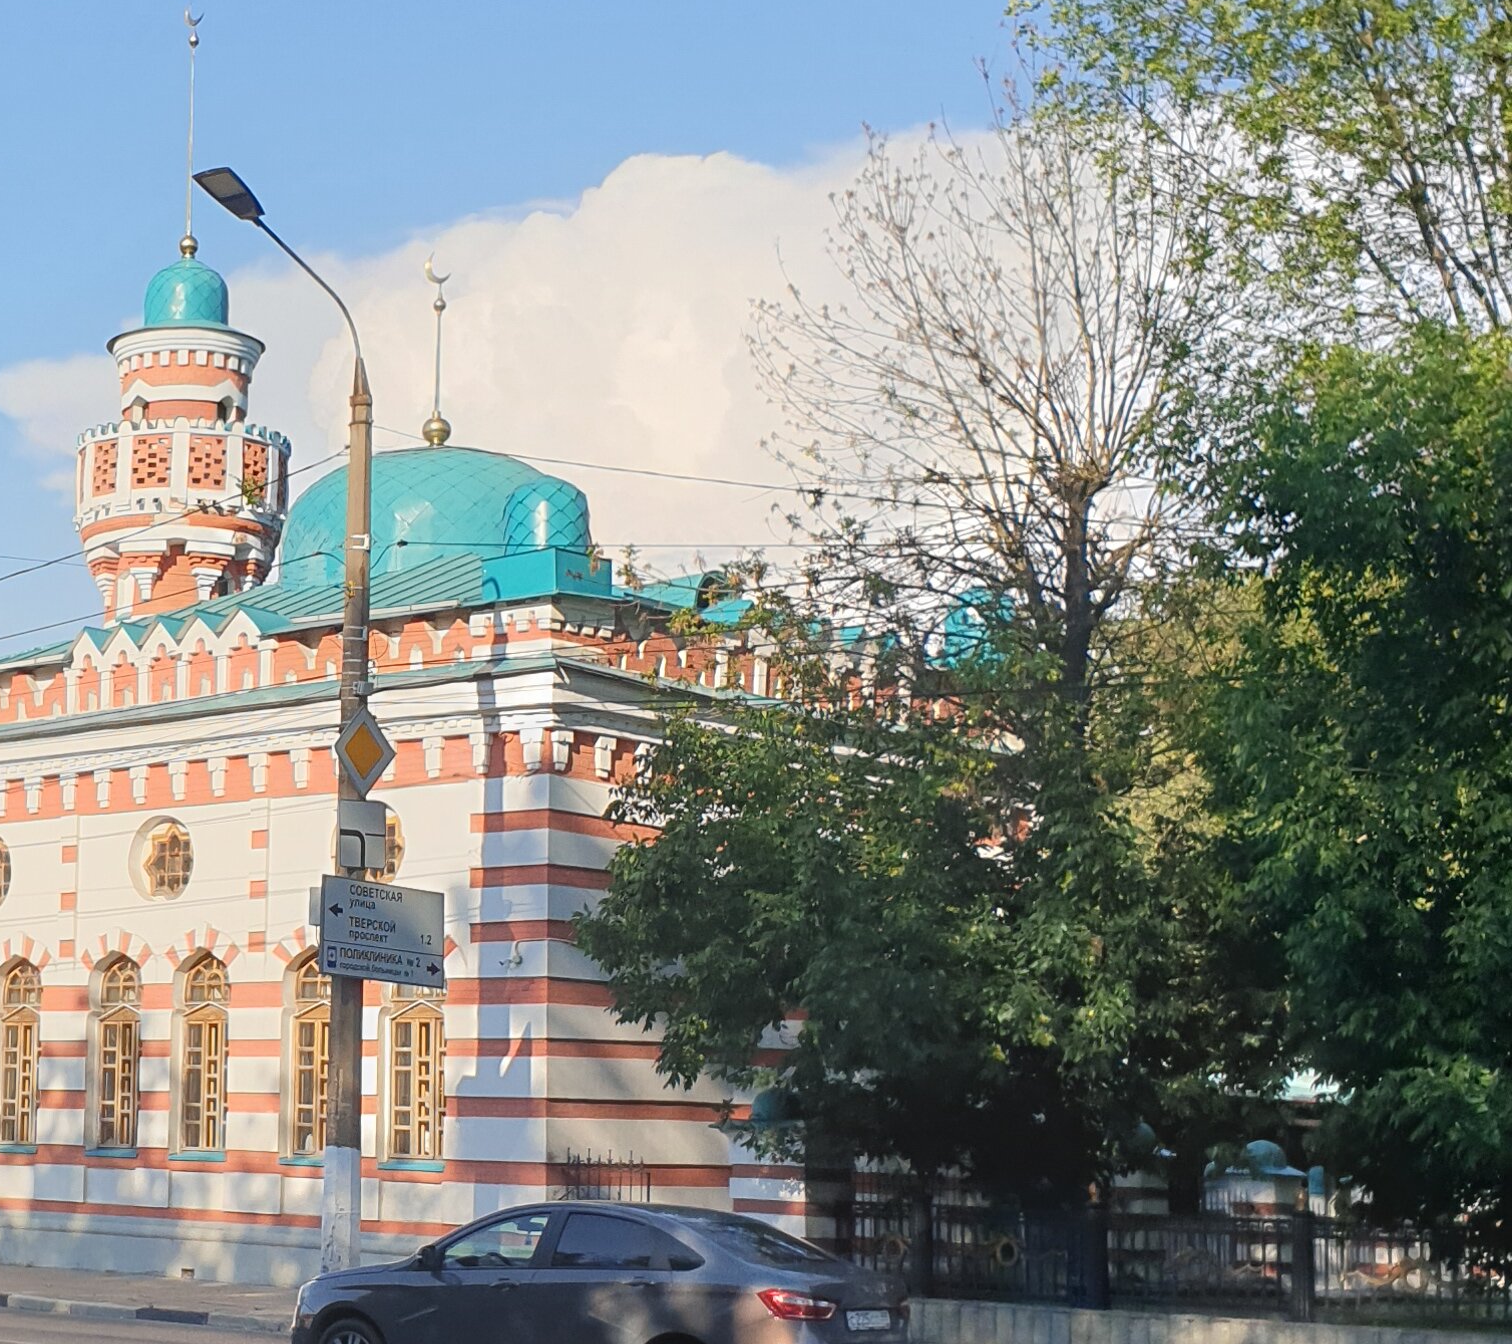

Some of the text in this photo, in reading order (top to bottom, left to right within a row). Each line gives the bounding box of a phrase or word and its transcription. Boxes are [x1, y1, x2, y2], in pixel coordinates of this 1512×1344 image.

[349, 884, 403, 903] СОВЕТСКАЯ
[349, 898, 376, 910] улица
[349, 916, 396, 933] ТВЕРСКОЙ
[349, 930, 389, 943] проспект
[339, 947, 403, 965] ПОЛИКЛИНИКА
[415, 957, 421, 968] 2
